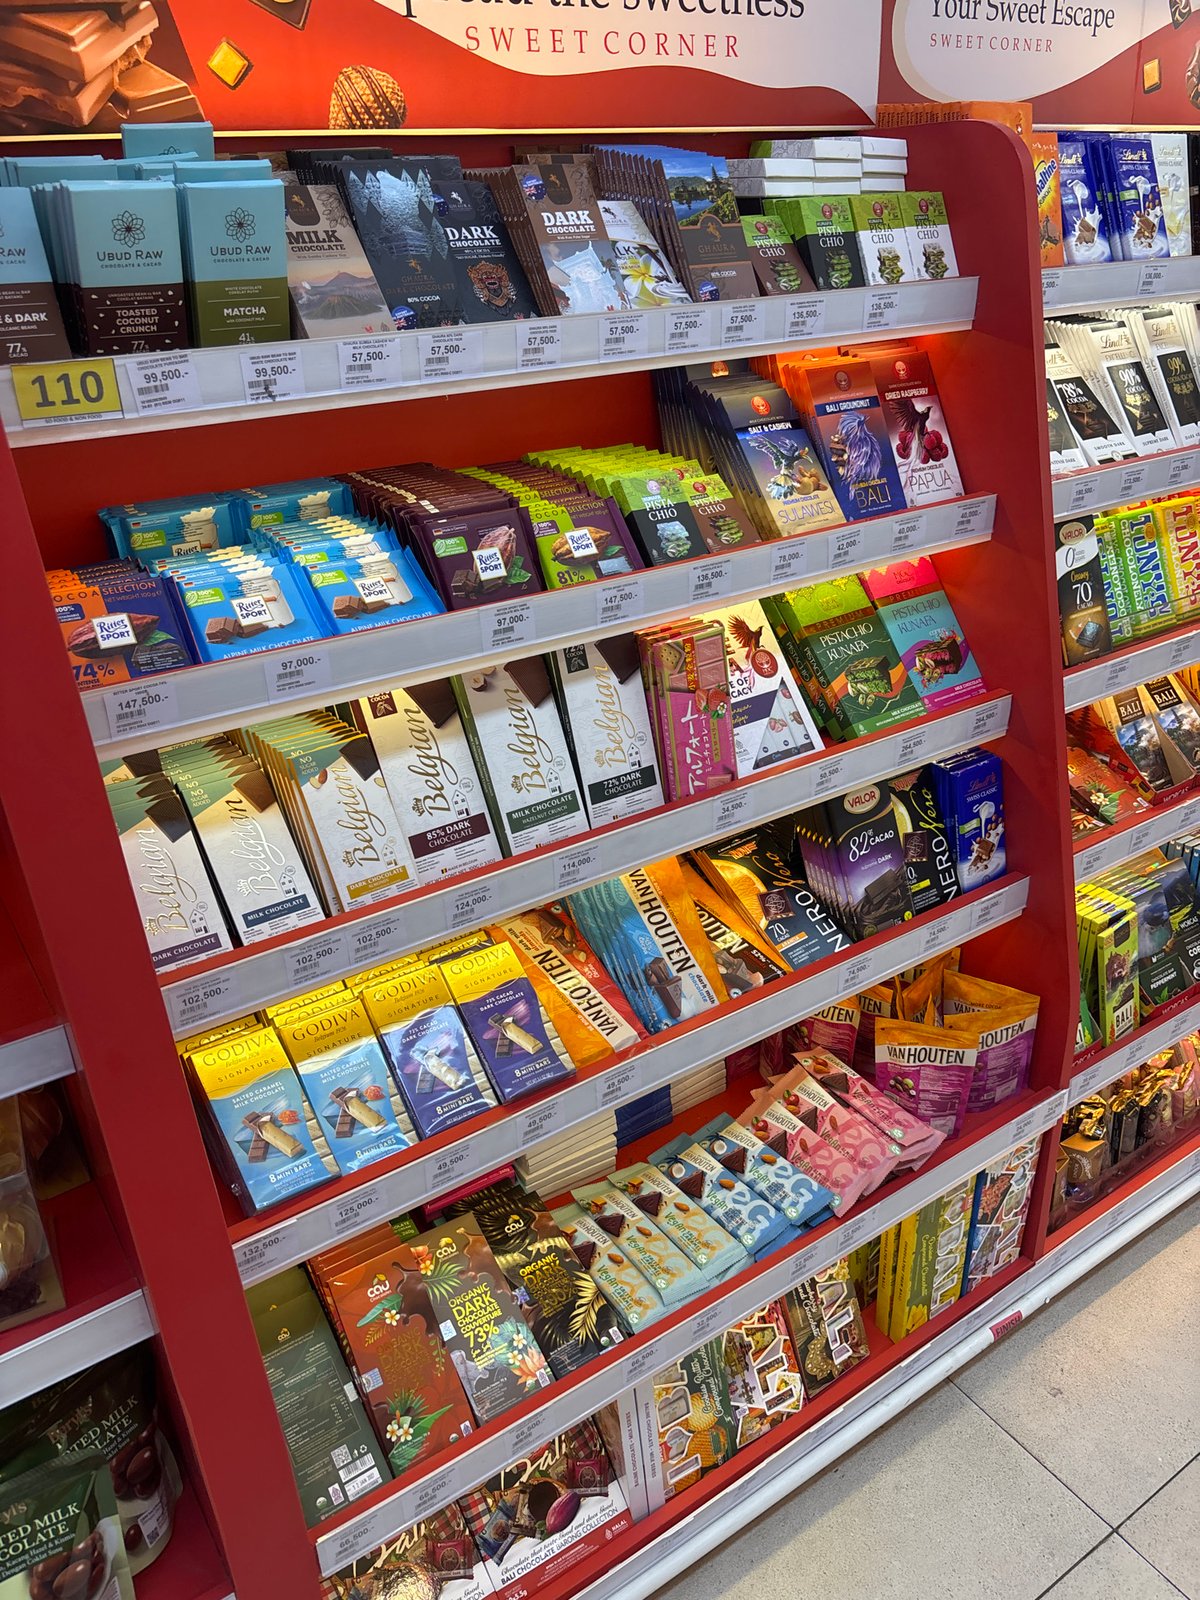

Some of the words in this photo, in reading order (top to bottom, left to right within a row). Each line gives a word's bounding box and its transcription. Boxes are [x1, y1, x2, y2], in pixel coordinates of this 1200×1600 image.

[932, 0, 980, 19] Your
[986, 0, 1046, 25] Sweet
[1051, 0, 1115, 37] Escape
[465, 26, 588, 55] SWEET
[603, 31, 739, 58] CORNER
[930, 33, 984, 50] SWEET
[989, 36, 1053, 53] CORNER
[541, 210, 591, 226] DARK
[288, 230, 342, 245] MILK
[446, 225, 499, 242] DARK
[546, 224, 596, 235] CHOCOLATE
[871, 234, 895, 244] CHIO
[917, 230, 940, 240] CHIO
[291, 243, 346, 253] CHOCOLATE
[450, 238, 502, 249] CHOCOLATE
[819, 237, 844, 248] CHIO
[759, 247, 786, 258] CHIO
[116, 307, 158, 318] TOASTED
[116, 315, 159, 326] COCONUT
[224, 305, 266, 317] MATCHA
[730, 312, 757, 324] 57,500.-
[120, 323, 158, 334] CRUNCH
[609, 324, 640, 336] 57,500.-
[674, 319, 704, 331] 57,500.-
[527, 334, 561, 346] 57,500.-
[351, 351, 391, 363] 57,500.-
[431, 344, 467, 356] 57,500.-
[143, 370, 189, 384] 99,500.-
[254, 365, 296, 378] 99,500.-
[1118, 367, 1140, 383] 90%
[30, 370, 105, 408] 110
[825, 403, 837, 414] BALI
[908, 471, 954, 492] PAPUA
[567, 501, 604, 514] SELECTION
[855, 488, 891, 510] BALI
[648, 508, 678, 522] CHIO
[699, 503, 726, 515] CHIO
[778, 501, 836, 526] SULAWESI
[568, 532, 592, 546] Ritter
[1061, 528, 1084, 540] VALOR
[572, 542, 594, 553] SPORT
[476, 551, 499, 566] Ritter
[479, 563, 502, 575] SPORT
[556, 568, 585, 586] 81%
[697, 569, 728, 582] 136,500.-
[102, 581, 156, 595] SELECTION
[357, 578, 384, 594] Ritter
[363, 587, 388, 600] SPORT
[235, 598, 264, 613] Ritter
[604, 592, 638, 605] 147,500.-
[240, 609, 268, 620] SPORT
[892, 597, 941, 622] PISTACHIO
[96, 617, 129, 634] Ritter
[496, 614, 530, 627] 97,000.-
[898, 617, 936, 634] KUNAFA
[100, 630, 131, 642] SPORT
[819, 622, 874, 648] PISTACHIO
[826, 640, 869, 662] KUNAFA
[72, 662, 115, 682] 74%
[281, 656, 321, 671] 97,000.-
[118, 694, 169, 710] 147,500.-
[1154, 689, 1177, 704] BALI
[593, 664, 636, 770] Belgian
[1119, 699, 1143, 717] BALI
[504, 687, 554, 795] Belgian
[299, 756, 312, 764] NO
[404, 705, 458, 817] Belgian
[602, 776, 619, 789] 72%
[620, 770, 641, 784] DARK
[604, 778, 644, 797] CHOCOLATE
[191, 789, 204, 797] NO
[847, 790, 877, 808] VALOR
[511, 807, 530, 821] MILK
[531, 794, 573, 815] CHOCOLATE
[721, 800, 748, 815] 34,500.-
[426, 827, 445, 842] 85%
[445, 819, 471, 836] DARK
[428, 828, 474, 849] CHOCOLATE
[869, 830, 894, 847] CACAO
[562, 855, 596, 872] 114,000.-
[350, 877, 368, 891] DARK
[368, 866, 404, 885] CHOCOLATE
[628, 868, 651, 902] VAN
[247, 909, 265, 922] MILK
[265, 897, 305, 917] CHOCOLATE
[455, 895, 493, 912] 124,000.-
[356, 926, 398, 946] 102,500.-
[638, 896, 696, 974] HOUTEN
[152, 950, 172, 963] DARK
[173, 936, 217, 957] CHOCOLATE
[295, 947, 340, 966] 102,500.-
[449, 946, 509, 975] GODIVA
[373, 969, 437, 1004] GODIVA
[465, 966, 514, 990] SIGNATURE
[182, 986, 229, 1007] 102,500.-
[388, 993, 440, 1019] SIGNATURE
[479, 1001, 495, 1012] DARK
[495, 991, 524, 1008] CHOCOLATE
[292, 1007, 361, 1042] GODIVA
[1115, 1006, 1133, 1029] BALI
[401, 1033, 418, 1044] DARK
[417, 1021, 449, 1039] CHOCOLATE
[202, 1032, 274, 1068] GODIVA
[306, 1031, 363, 1059] SIGNATURE
[887, 1045, 906, 1061] VAN
[906, 1045, 965, 1065] HOUTEN
[218, 1056, 278, 1083] SIGNATURE
[320, 1066, 341, 1079] SALTED
[340, 1057, 368, 1072] CARAMEL
[322, 1073, 338, 1085] MILK
[338, 1060, 372, 1080] CHOCOLATE
[514, 1067, 521, 1077] 8
[521, 1062, 536, 1077] MINI
[535, 1057, 552, 1072] BARS
[606, 1073, 636, 1091] 49,500.-
[232, 1090, 254, 1104] SALTED
[254, 1080, 283, 1097] CARAMEL
[234, 1098, 250, 1110] MILK
[249, 1085, 286, 1104] CHOCOLATE
[527, 1111, 557, 1129] 49,500.-
[269, 1173, 277, 1184] 8
[277, 1166, 294, 1182] MINI
[294, 1160, 312, 1175] BARS
[437, 1153, 470, 1172] 49,500.-
[338, 1196, 379, 1219] 125,000.-
[242, 1235, 288, 1257] 132,500.-
[519, 1252, 559, 1278] ORGANIC
[447, 1282, 491, 1309] ORGANIC
[451, 1292, 496, 1322] DARK
[457, 1302, 501, 1328] CHOCOLATE
[460, 1309, 503, 1335] COUVERTURE
[995, 1313, 1022, 1340] FINISH
[463, 1323, 500, 1348] 73%
[103, 1395, 139, 1431] MILK
[418, 1478, 452, 1502] 66,500.-
[35, 1502, 80, 1530] MILK
[501, 1573, 516, 1587] BALI
[516, 1550, 555, 1579] CHOCOLATE
[556, 1533, 581, 1554] BARONG
[581, 1507, 618, 1537] COLLECTION
